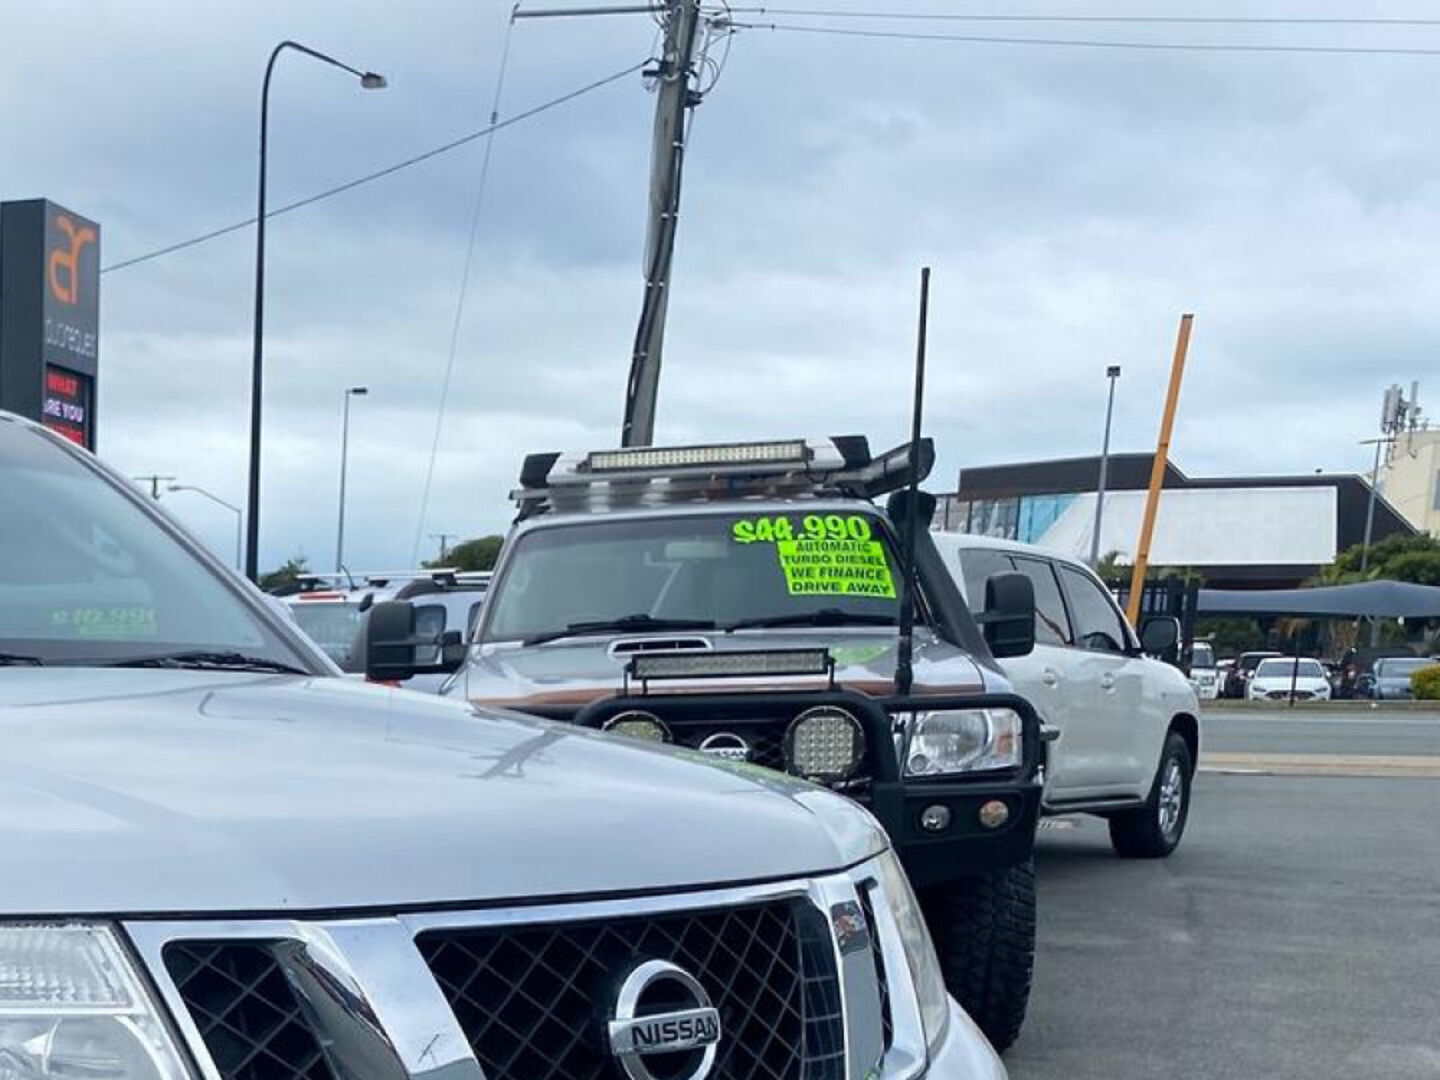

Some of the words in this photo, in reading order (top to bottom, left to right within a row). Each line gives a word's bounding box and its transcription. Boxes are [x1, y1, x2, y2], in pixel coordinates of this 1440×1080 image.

[796, 541, 872, 553] AUTOMATIC
[784, 555, 831, 565] TURBO
[835, 555, 885, 566] DIESEL
[792, 567, 814, 579] WE
[820, 567, 883, 579] FINANCE
[792, 581, 839, 593] DRIVE
[847, 582, 890, 594] AWAY
[632, 1016, 717, 1046] NISSAN
